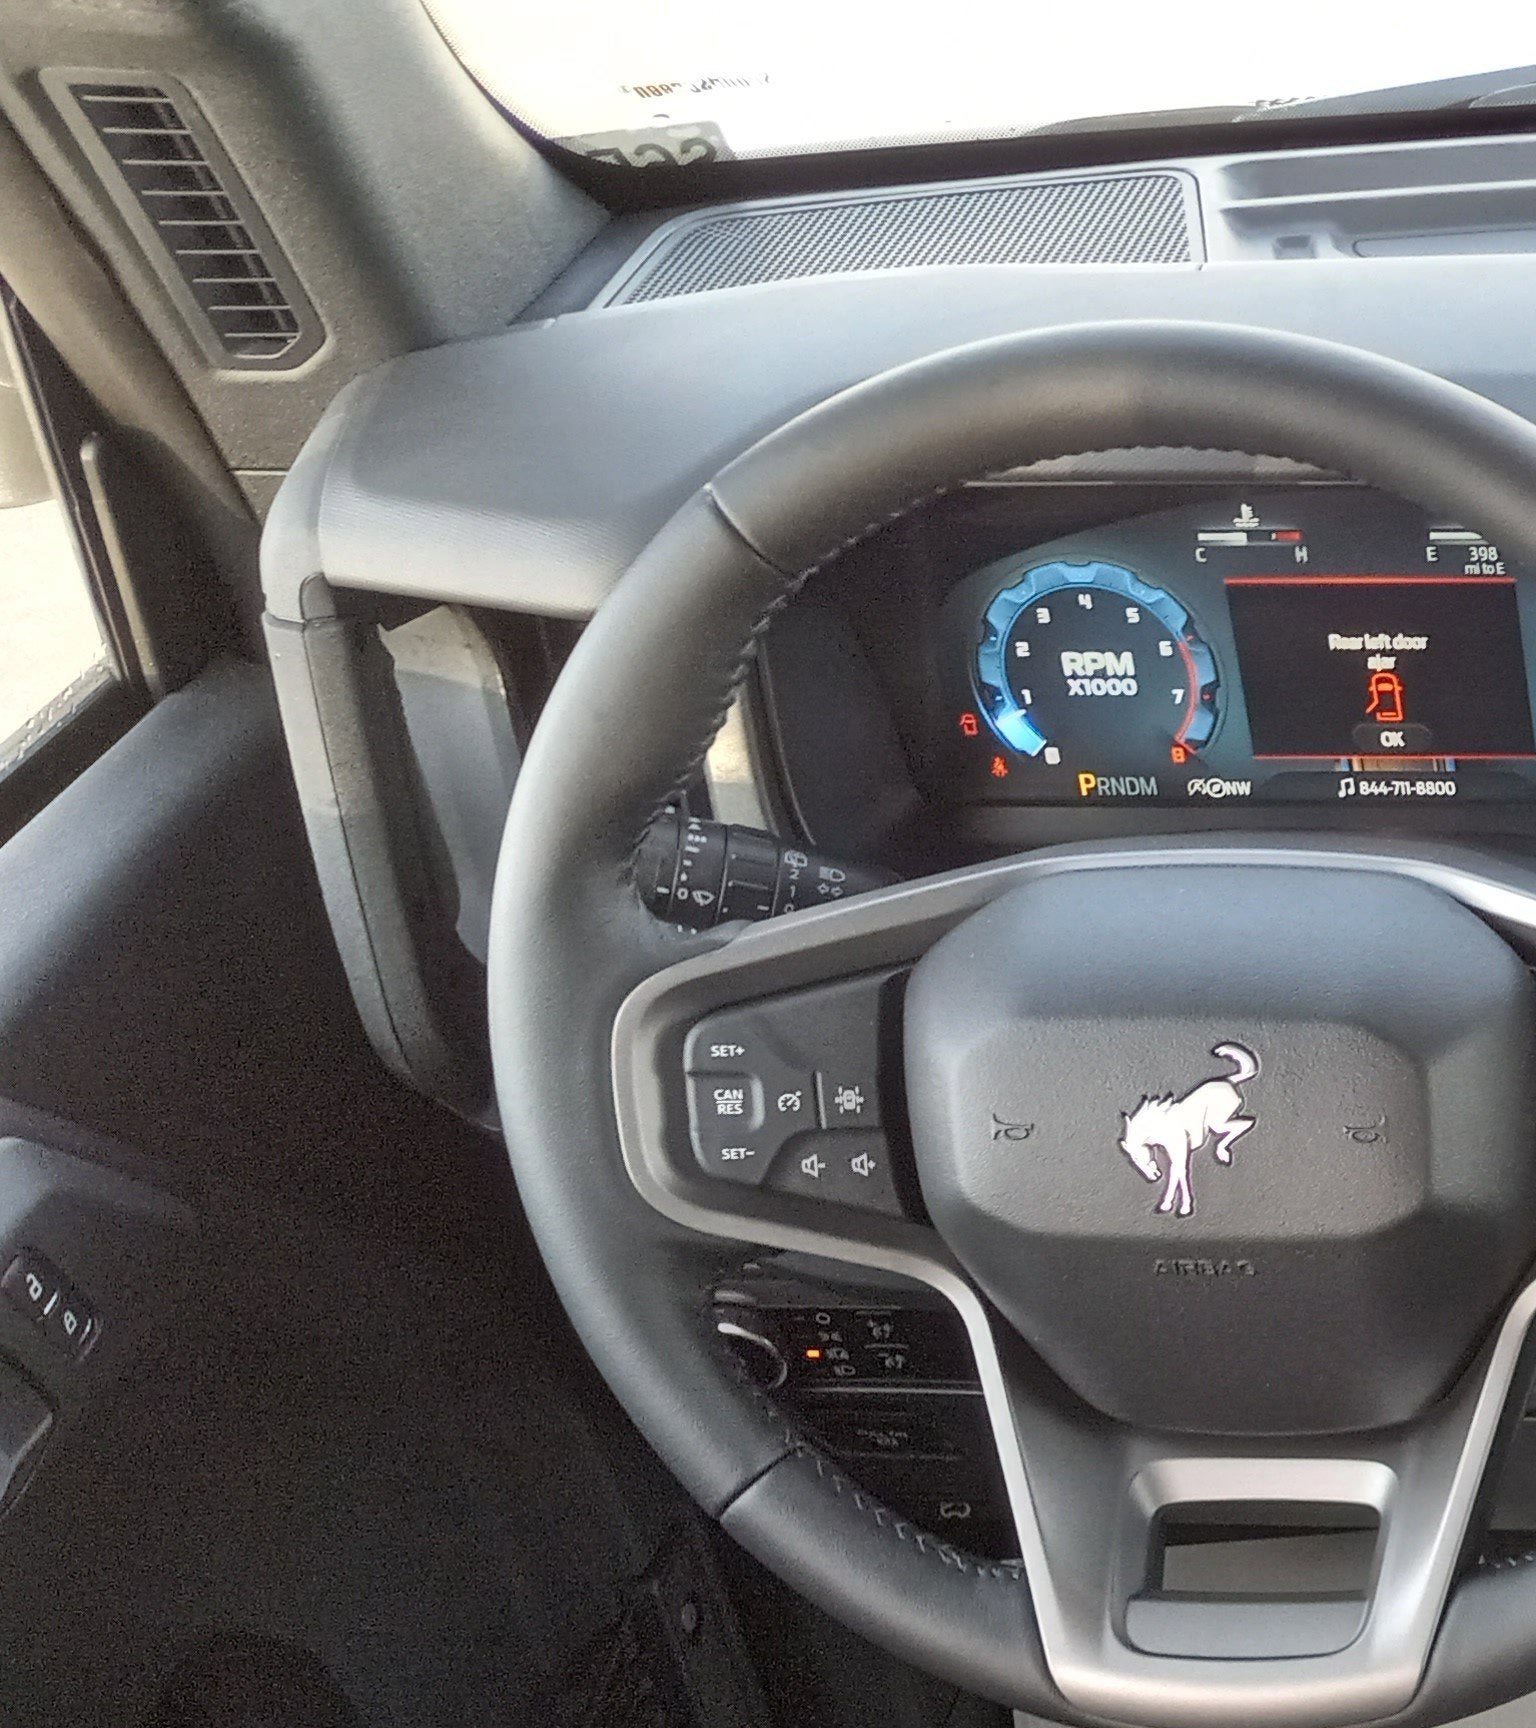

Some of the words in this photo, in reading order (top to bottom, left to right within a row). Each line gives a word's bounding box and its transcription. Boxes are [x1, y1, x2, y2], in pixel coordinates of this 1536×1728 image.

[1426, 546, 1438, 562] E
[1468, 546, 1498, 561] 398
[1078, 594, 1093, 610] 4
[1036, 607, 1051, 624] 3
[1125, 607, 1140, 624] 5
[1015, 641, 1030, 657] 2
[1158, 641, 1173, 657] 6
[1060, 651, 1136, 677] RPM
[1067, 678, 1138, 697] X1000
[1021, 689, 1032, 704] 1
[1171, 689, 1185, 704] 7
[1380, 731, 1405, 747] OK
[1359, 780, 1456, 797] 844-711-8800
[710, 1044, 745, 1058] SET+
[713, 1089, 743, 1100] CAN
[716, 1104, 743, 1115] RES
[722, 1148, 755, 1160] SET-
